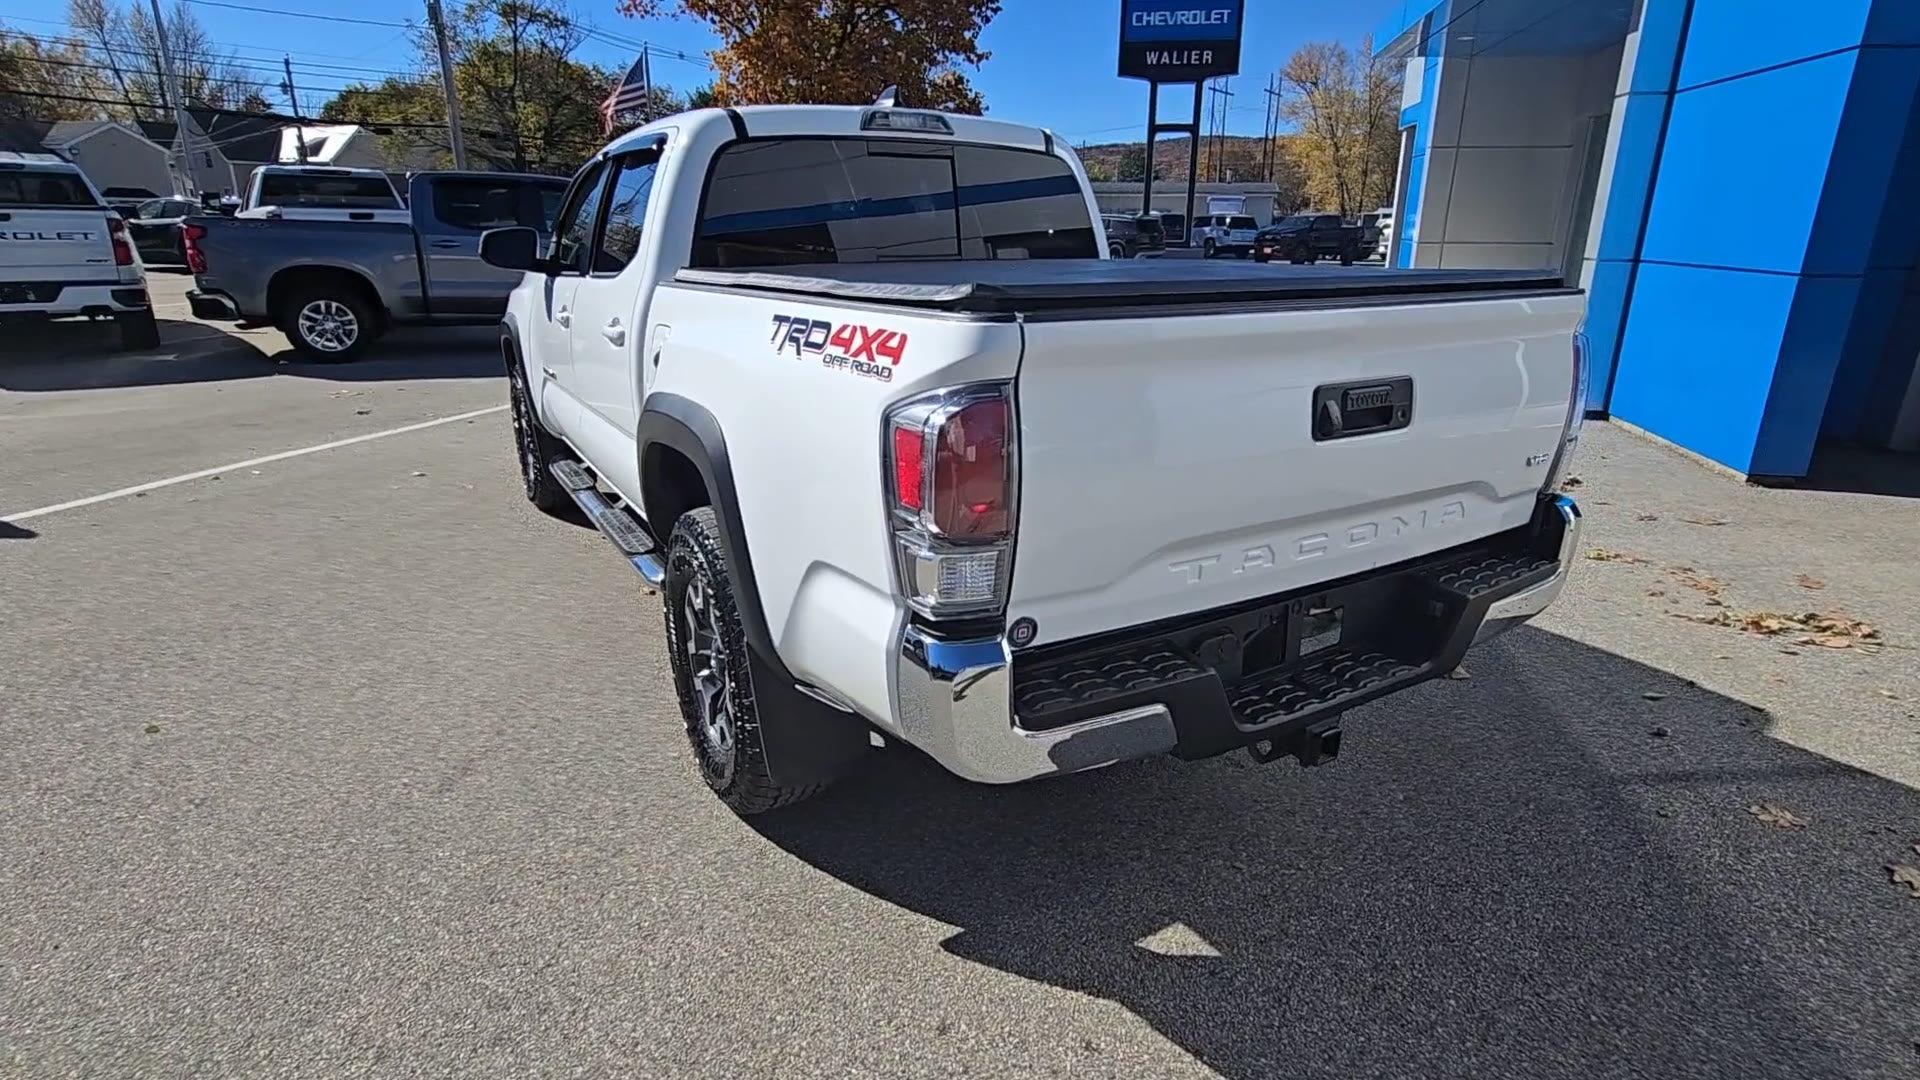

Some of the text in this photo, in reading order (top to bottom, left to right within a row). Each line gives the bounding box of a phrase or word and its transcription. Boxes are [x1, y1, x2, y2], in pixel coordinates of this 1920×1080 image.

[1132, 9, 1231, 26] CHEVROLET
[1146, 50, 1213, 65] WALIER
[770, 314, 832, 358] TRD
[822, 353, 893, 381] OFF ROAD
[1348, 389, 1393, 409] TOYOTA
[1168, 500, 1466, 584] TACOMA
